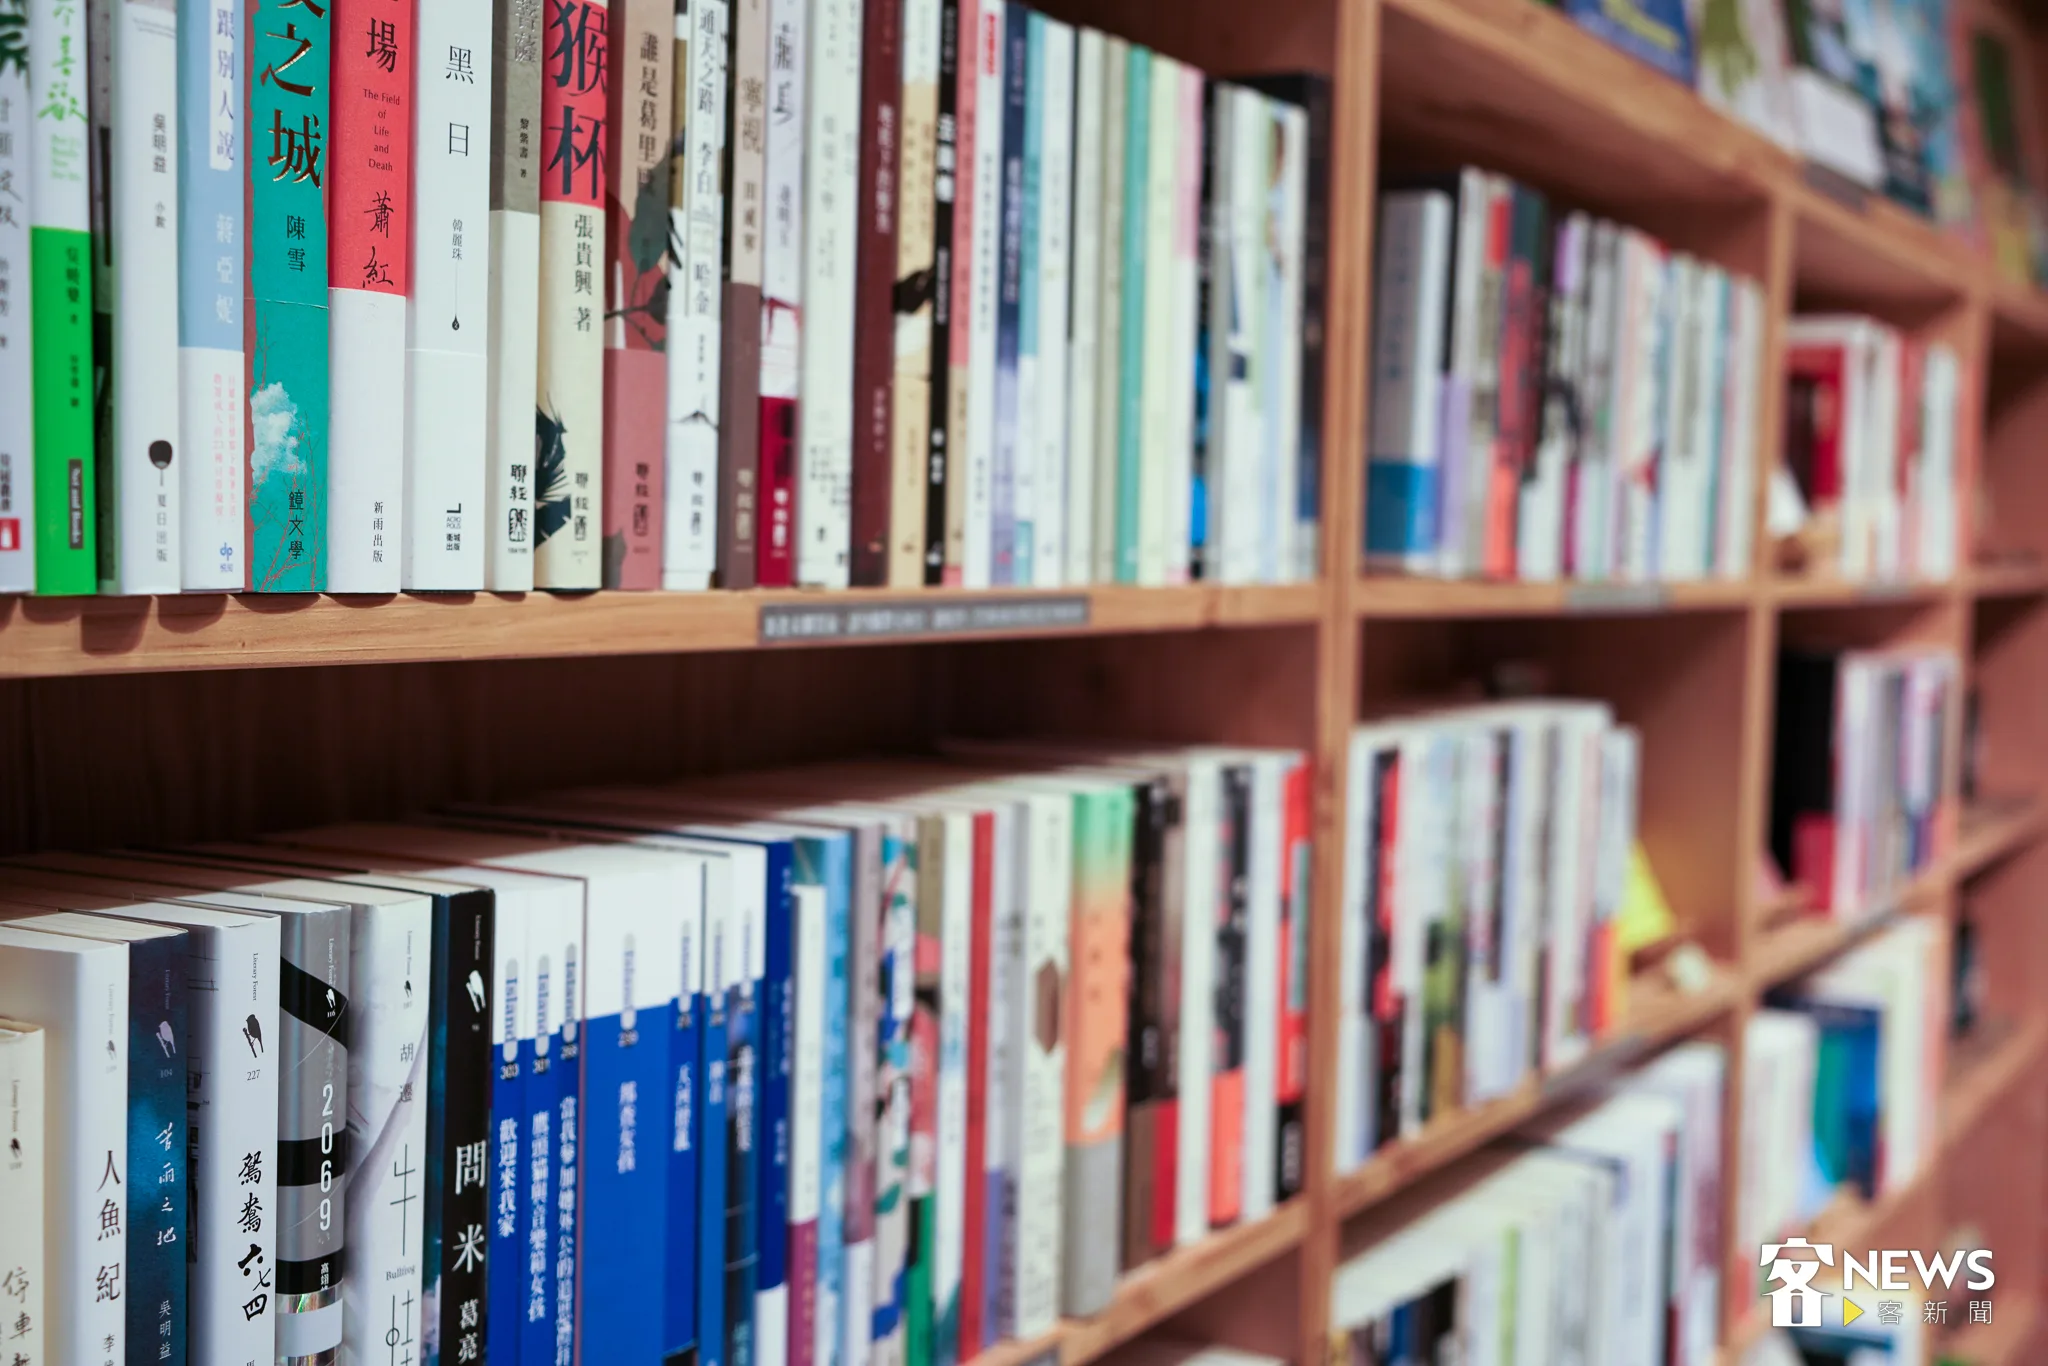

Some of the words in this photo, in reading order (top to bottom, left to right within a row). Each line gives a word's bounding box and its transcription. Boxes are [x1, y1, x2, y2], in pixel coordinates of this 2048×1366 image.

[366, 17, 398, 73] 場
[216, 8, 235, 161] 跟別人說
[259, 0, 326, 189] 之城
[363, 88, 379, 101] The
[381, 92, 400, 106] Field
[377, 109, 387, 119] of
[445, 45, 474, 157] 黑日
[546, 0, 608, 200] 猴杯
[373, 125, 390, 137] Life
[373, 144, 389, 154] and
[367, 158, 393, 172] Death
[286, 215, 306, 273] 陳雪
[362, 189, 394, 289] 蕭紅
[451, 218, 463, 261] 韓麗珠
[574, 213, 593, 296] 張貴興
[509, 464, 527, 501] 聯經
[288, 489, 305, 559] 鏡文學
[372, 501, 384, 563] 新雨出版
[506, 978, 518, 1042] Island
[537, 973, 549, 1037] Island
[246, 1069, 261, 1082] 227
[400, 1043, 414, 1103] 胡遷
[155, 1121, 177, 1246] 苦雨之地
[318, 1083, 334, 1232] 2069
[95, 1150, 122, 1303] 人魚紀
[237, 1150, 272, 1322] 鴛鴦六七四
[452, 1140, 487, 1275] 問米
[158, 1299, 172, 1361] 吳明益
[458, 1298, 479, 1365] 葛亮
